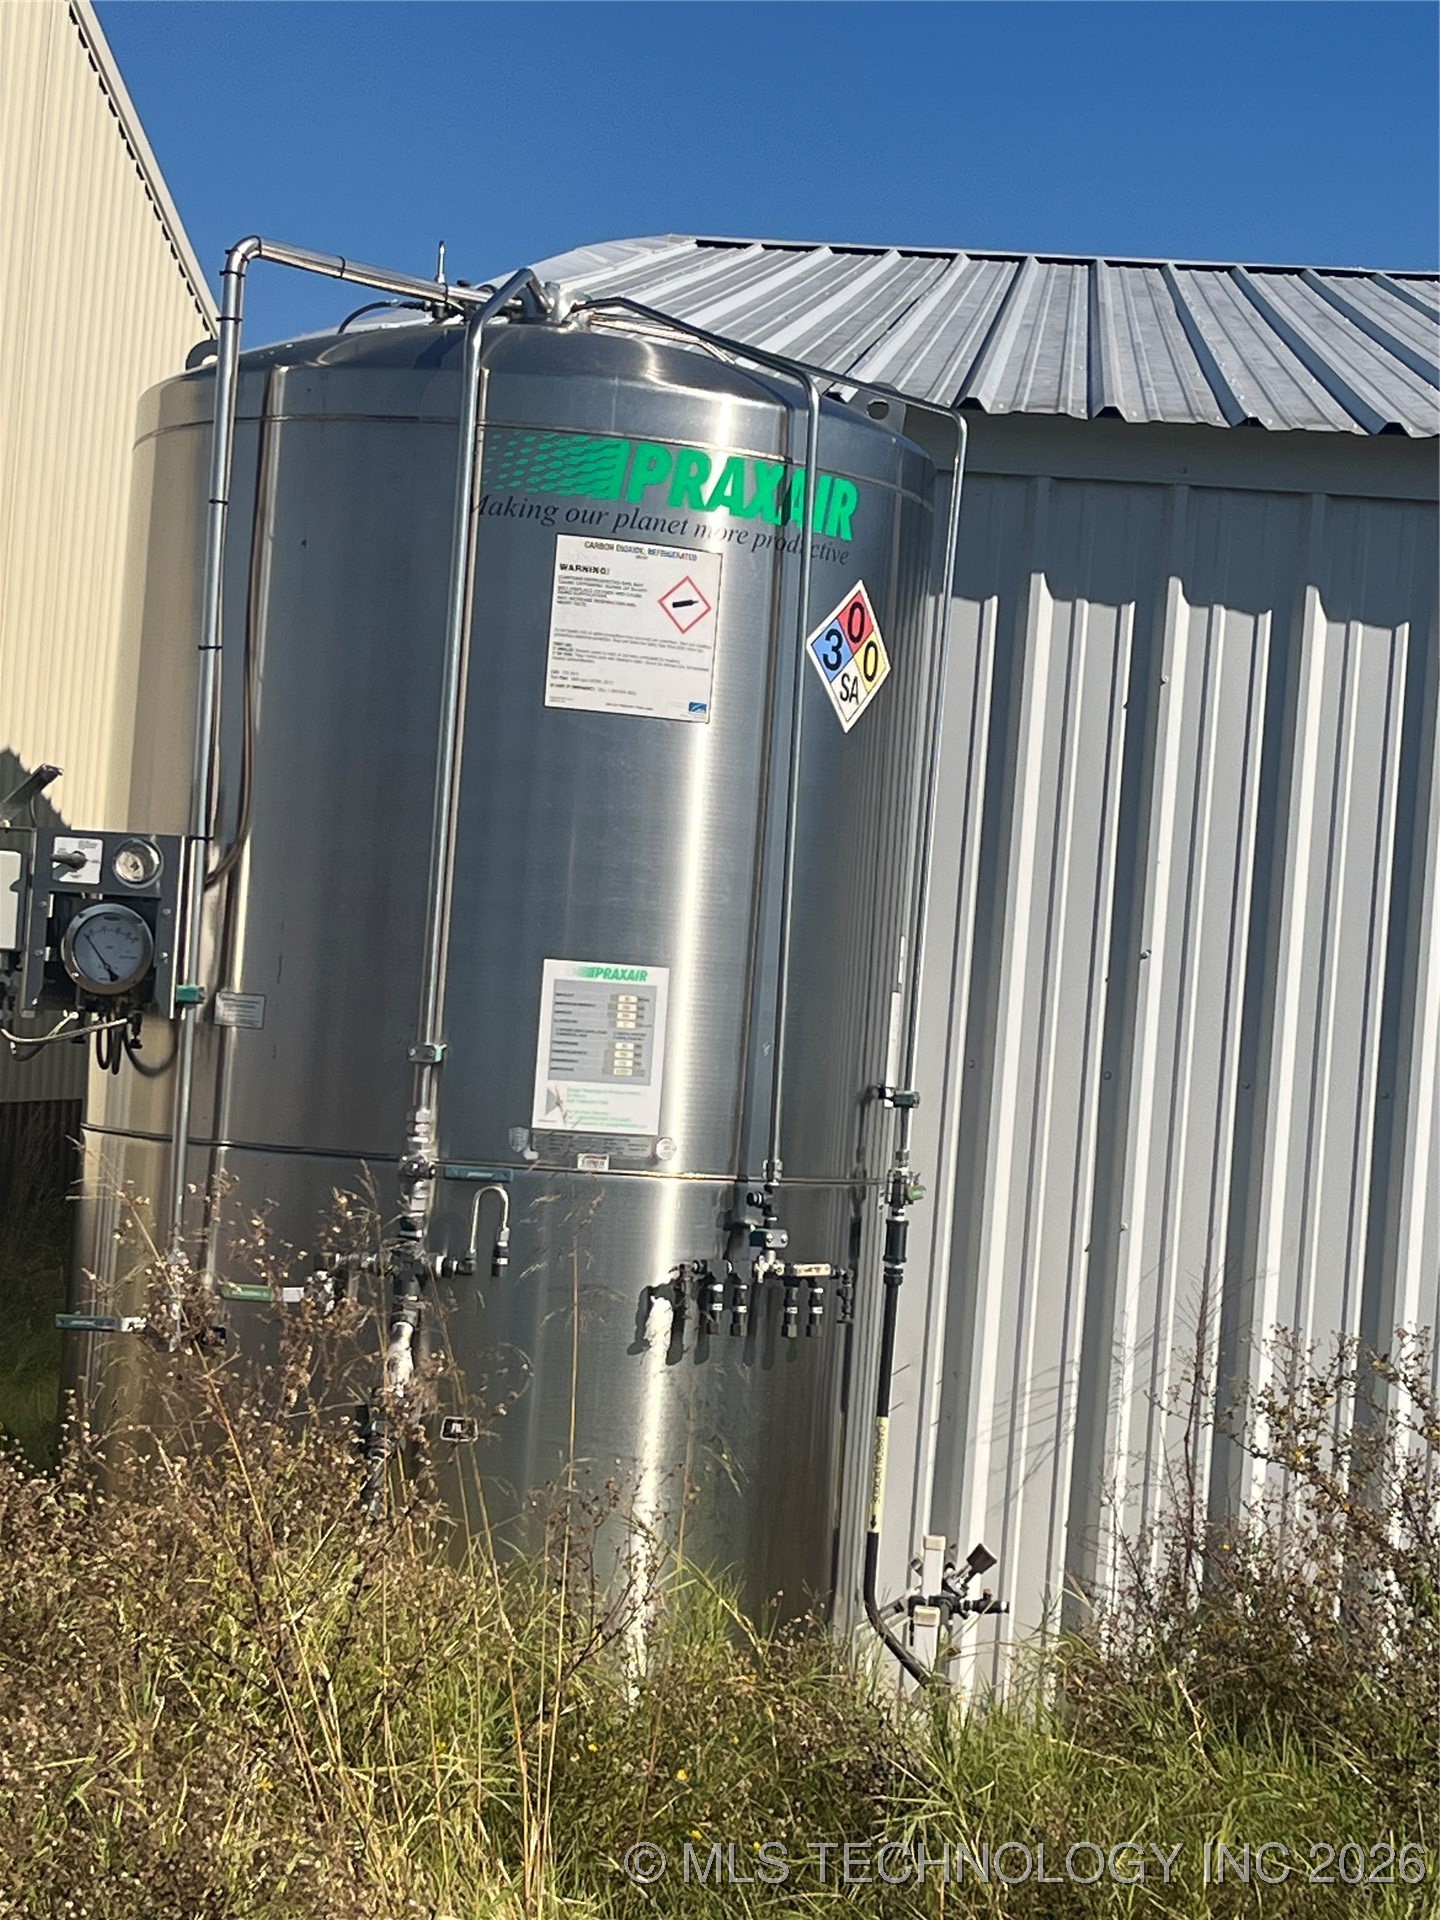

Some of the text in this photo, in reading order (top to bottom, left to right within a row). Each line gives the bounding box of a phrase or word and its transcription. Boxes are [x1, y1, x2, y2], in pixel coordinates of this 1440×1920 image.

[625, 442, 858, 541] PRAXAIR
[565, 507, 609, 525] our
[611, 507, 688, 534] planet
[693, 522, 749, 545] more
[751, 531, 850, 565] prodctive
[584, 541, 615, 551] CARBON
[848, 601, 865, 644] 0
[823, 628, 843, 671] 3
[863, 640, 878, 682] 0
[840, 673, 859, 705] SA
[595, 967, 648, 982] PRAXAIR
